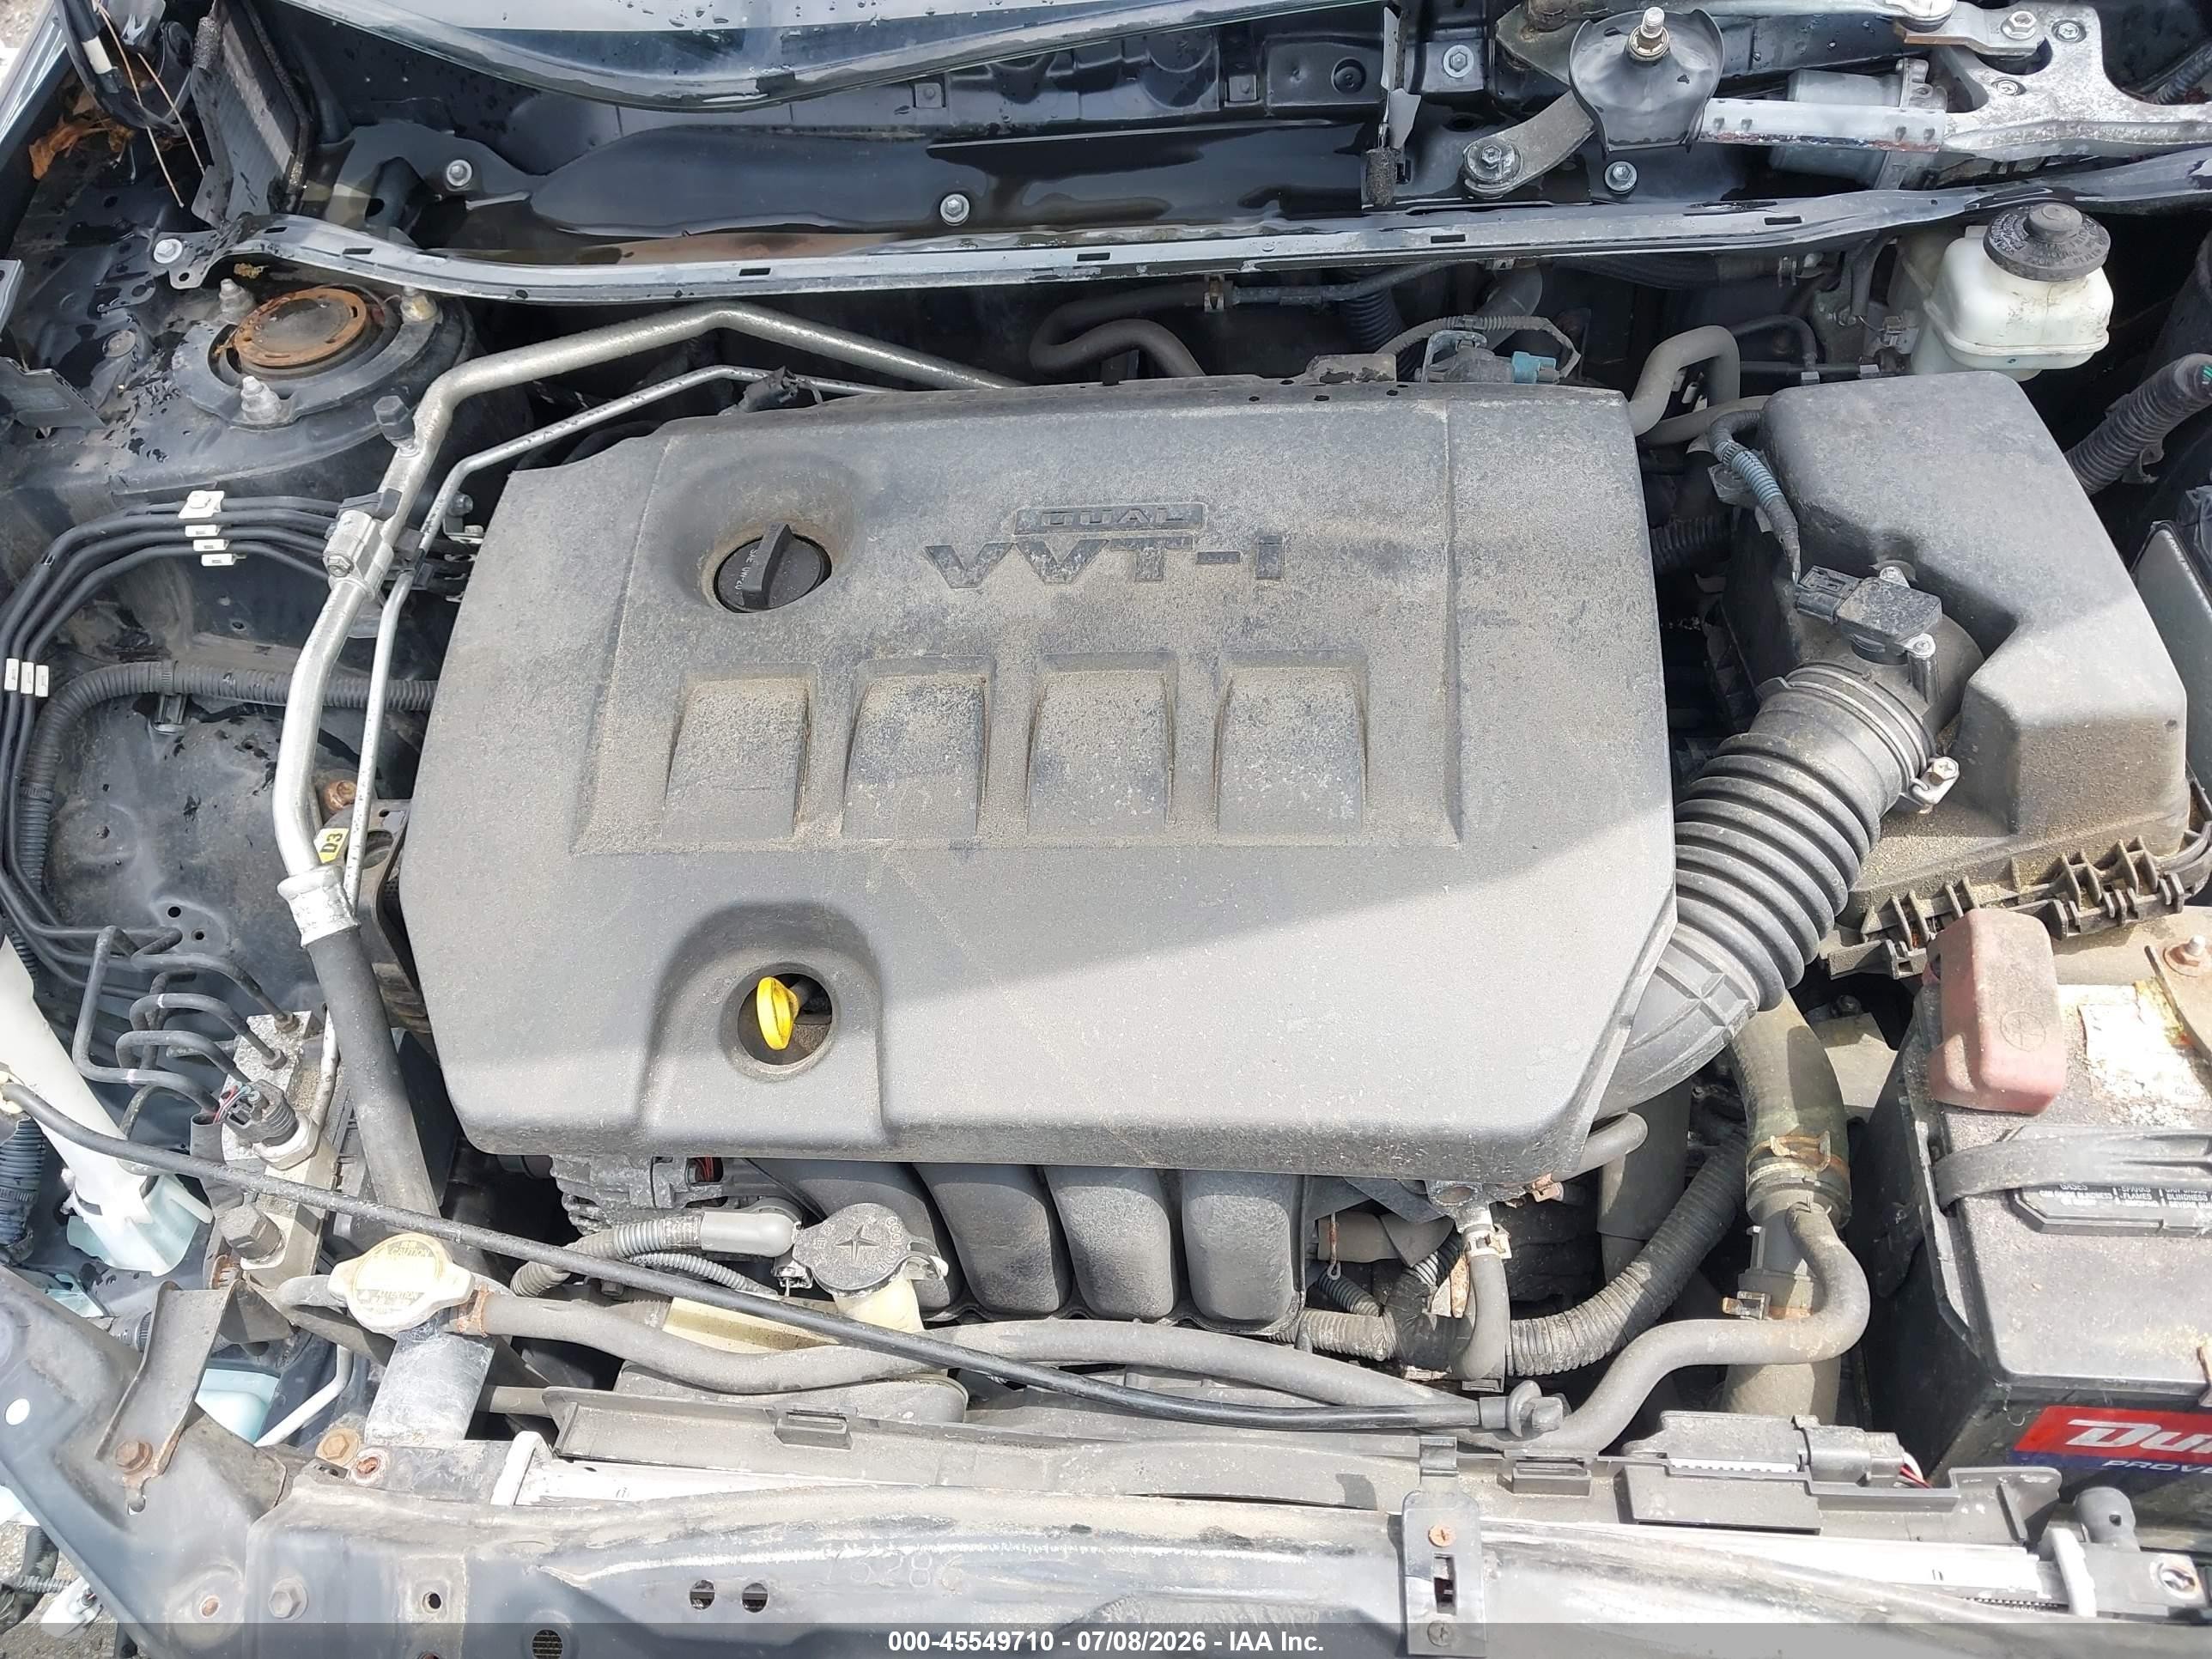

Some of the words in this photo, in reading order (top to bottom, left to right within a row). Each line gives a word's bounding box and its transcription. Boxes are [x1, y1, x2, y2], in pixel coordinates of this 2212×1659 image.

[1041, 508, 1186, 526] DUAL
[319, 833, 343, 853] D3
[2060, 1182, 2088, 1191] GASES
[391, 1247, 429, 1258] CAUTION
[377, 1290, 418, 1301] ATTENTION
